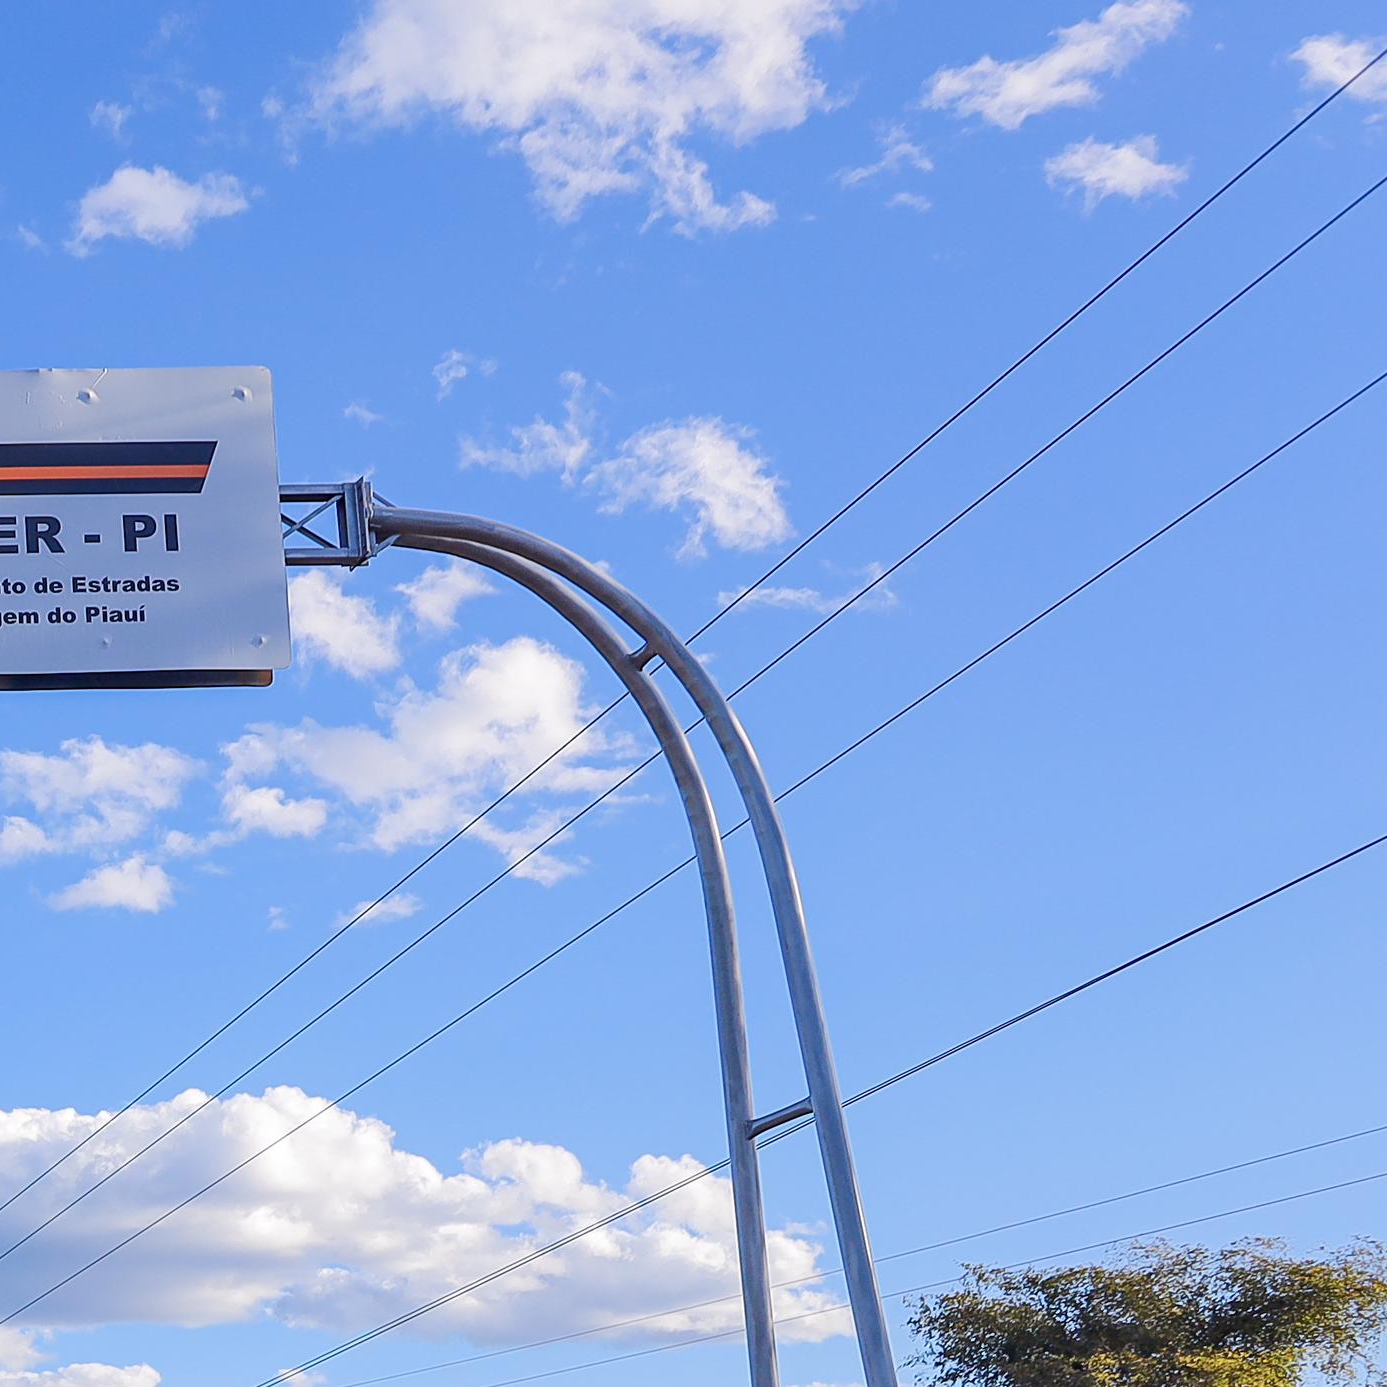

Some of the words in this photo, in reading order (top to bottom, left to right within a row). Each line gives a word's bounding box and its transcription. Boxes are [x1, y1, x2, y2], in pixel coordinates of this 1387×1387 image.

[83, 533, 101, 543] -
[121, 512, 180, 552] PI
[33, 577, 64, 595] de
[71, 575, 180, 594] Estradas
[47, 605, 77, 625] do
[85, 604, 147, 624] Piauí
